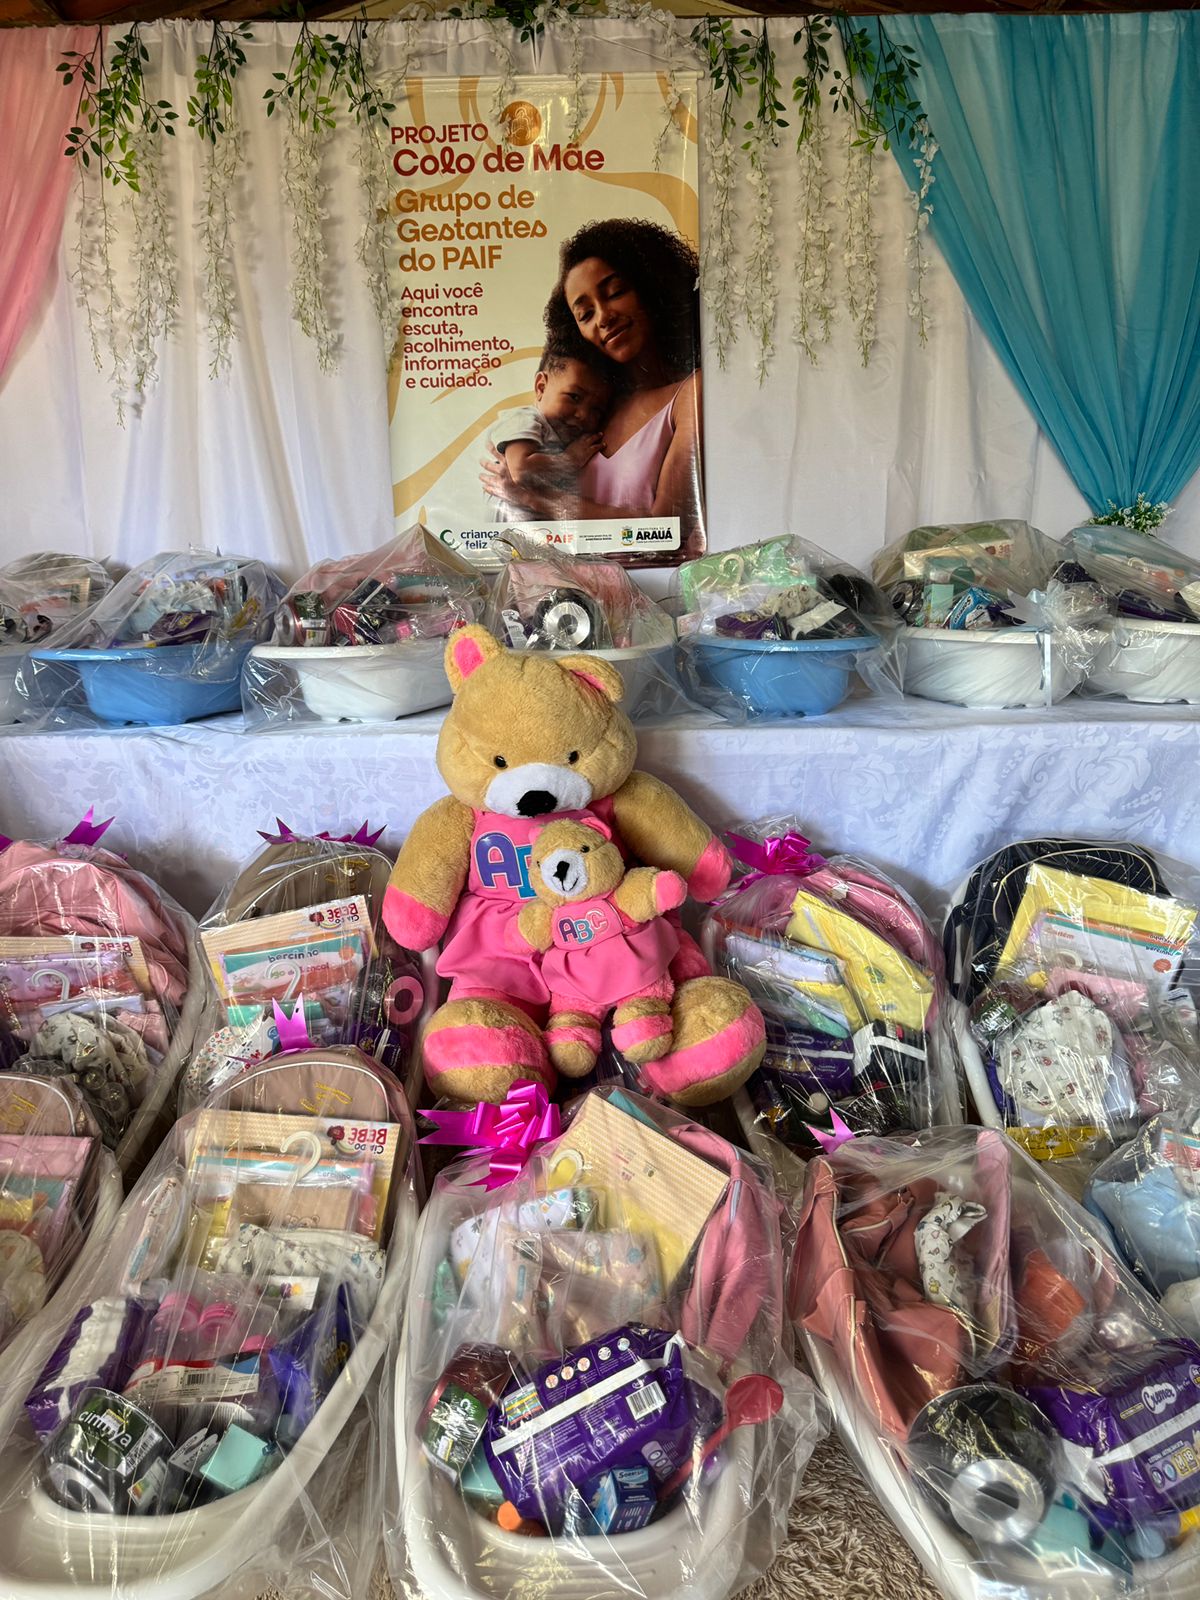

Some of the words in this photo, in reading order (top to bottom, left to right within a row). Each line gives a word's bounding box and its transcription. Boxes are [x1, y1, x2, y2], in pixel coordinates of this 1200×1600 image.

[391, 123, 488, 144] PROJETO
[393, 146, 475, 176] Colo
[482, 145, 525, 173] de
[533, 143, 605, 171] Mãe
[395, 189, 492, 216] Grupo
[498, 184, 535, 209] de
[397, 216, 548, 243] Gestantes
[398, 248, 436, 272] do
[442, 245, 503, 271] PAIF
[400, 284, 440, 303] Aqui
[442, 282, 484, 300] você
[402, 302, 478, 318] encontra
[402, 320, 464, 337] escuta,
[404, 337, 515, 354] acolhimento,
[404, 354, 502, 375] informação
[406, 376, 417, 389] e
[420, 371, 492, 389] cuidado.
[460, 530, 500, 544] criança
[636, 527, 673, 541] ARAUÁ
[465, 540, 488, 550] feliz
[558, 907, 610, 945] ABC
